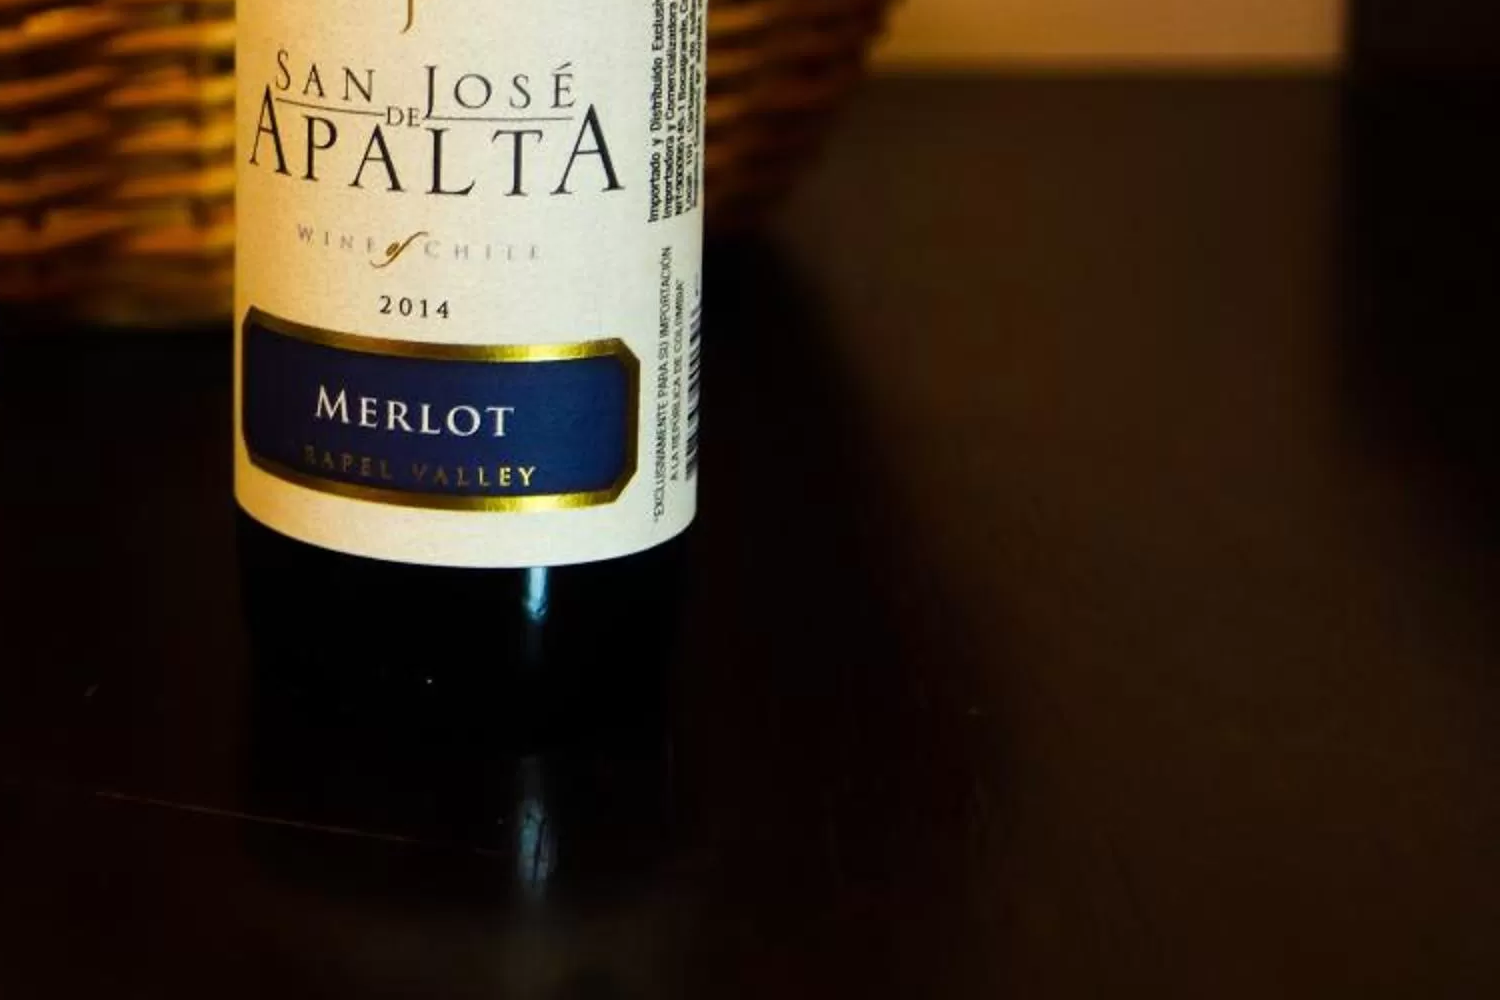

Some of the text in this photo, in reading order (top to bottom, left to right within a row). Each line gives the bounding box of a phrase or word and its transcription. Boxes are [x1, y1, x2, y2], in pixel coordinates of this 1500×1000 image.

[274, 48, 577, 120] SAN JOSÉ
[665, 2, 677, 120] Comercializadora
[386, 105, 421, 128] DE
[649, 57, 663, 132] Distribuido
[249, 83, 625, 197] APALTA
[651, 137, 664, 147] y
[647, 152, 661, 223] Importado
[662, 135, 674, 219] Importadora
[297, 223, 541, 269] WINE of CHILE
[379, 295, 451, 319] 2014
[656, 363, 668, 398] PARA
[316, 384, 516, 438] MERLOT
[303, 445, 537, 488] RAPEL VALLEY
